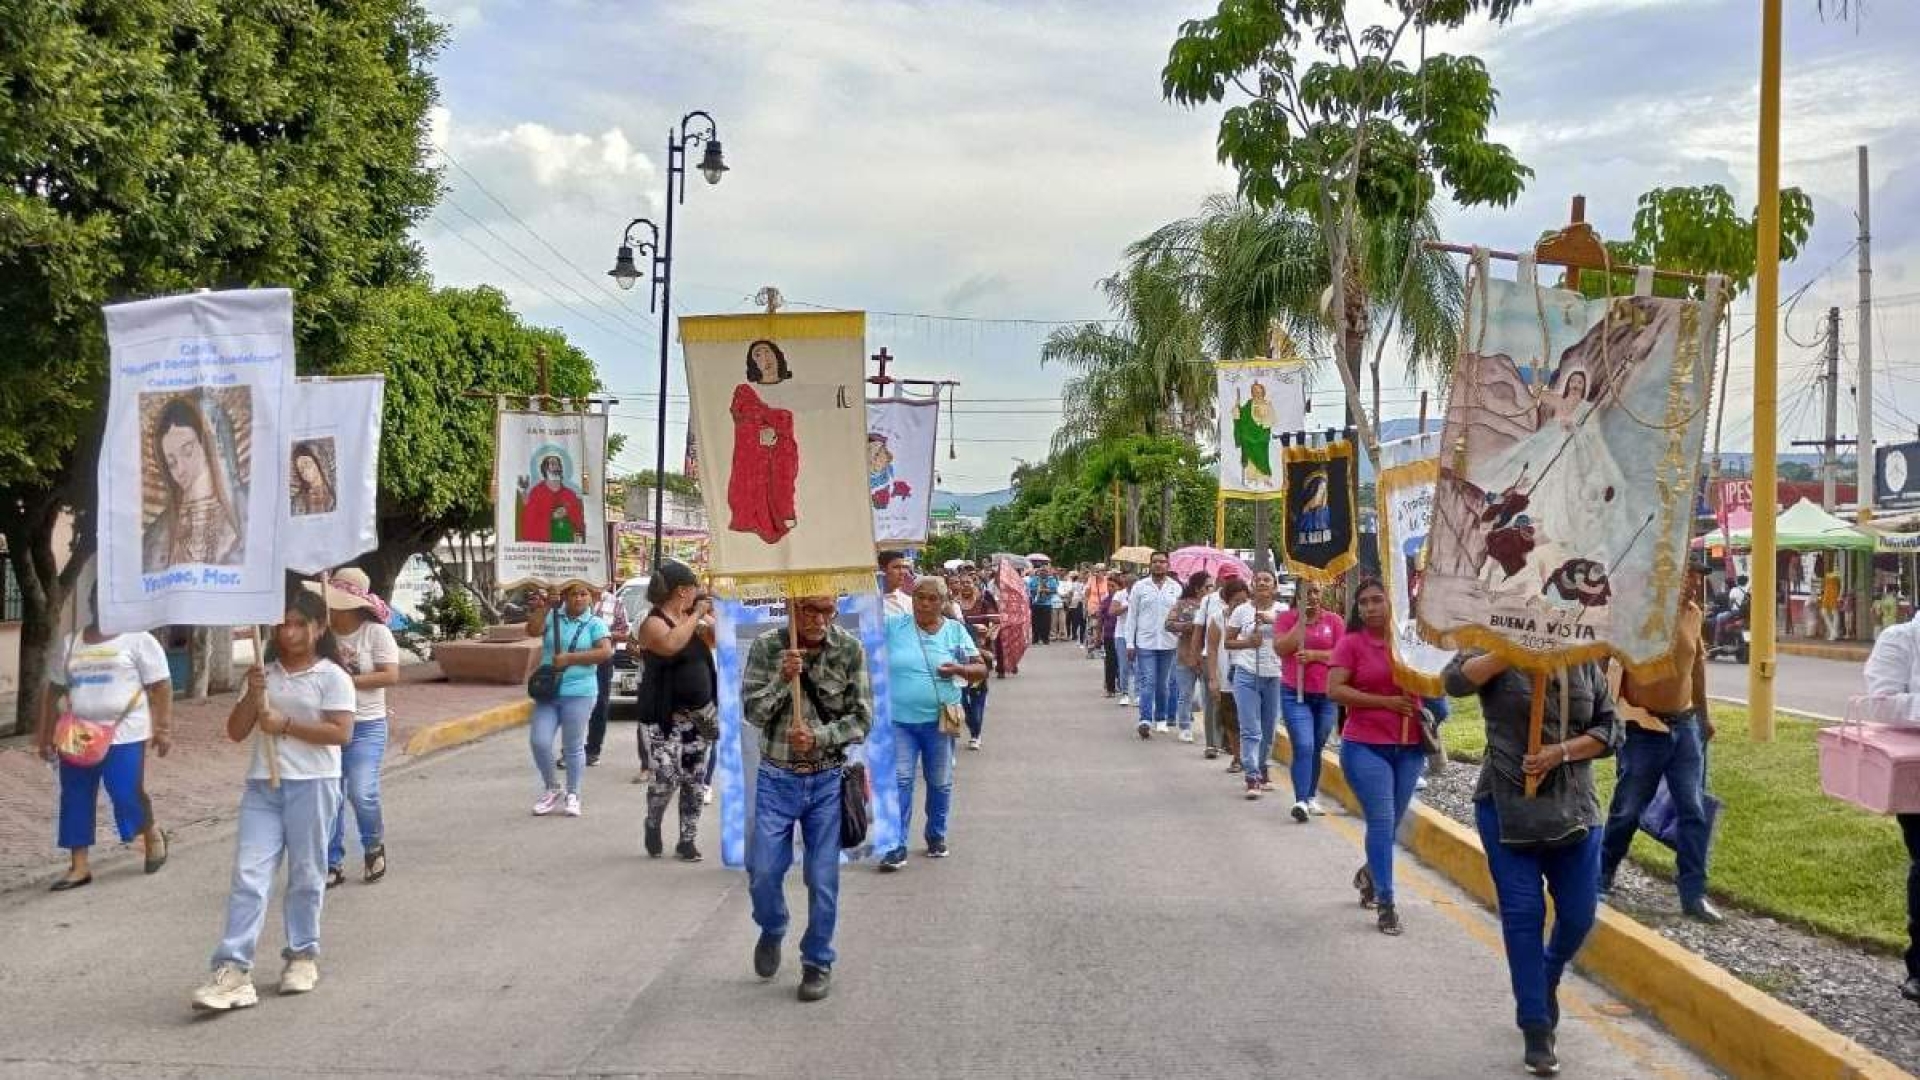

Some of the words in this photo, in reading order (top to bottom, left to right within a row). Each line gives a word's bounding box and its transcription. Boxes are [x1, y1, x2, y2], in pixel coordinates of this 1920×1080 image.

[204, 568, 241, 586] Mor.
[1490, 613, 1537, 633] BUENA
[1546, 621, 1596, 641] VISTA
